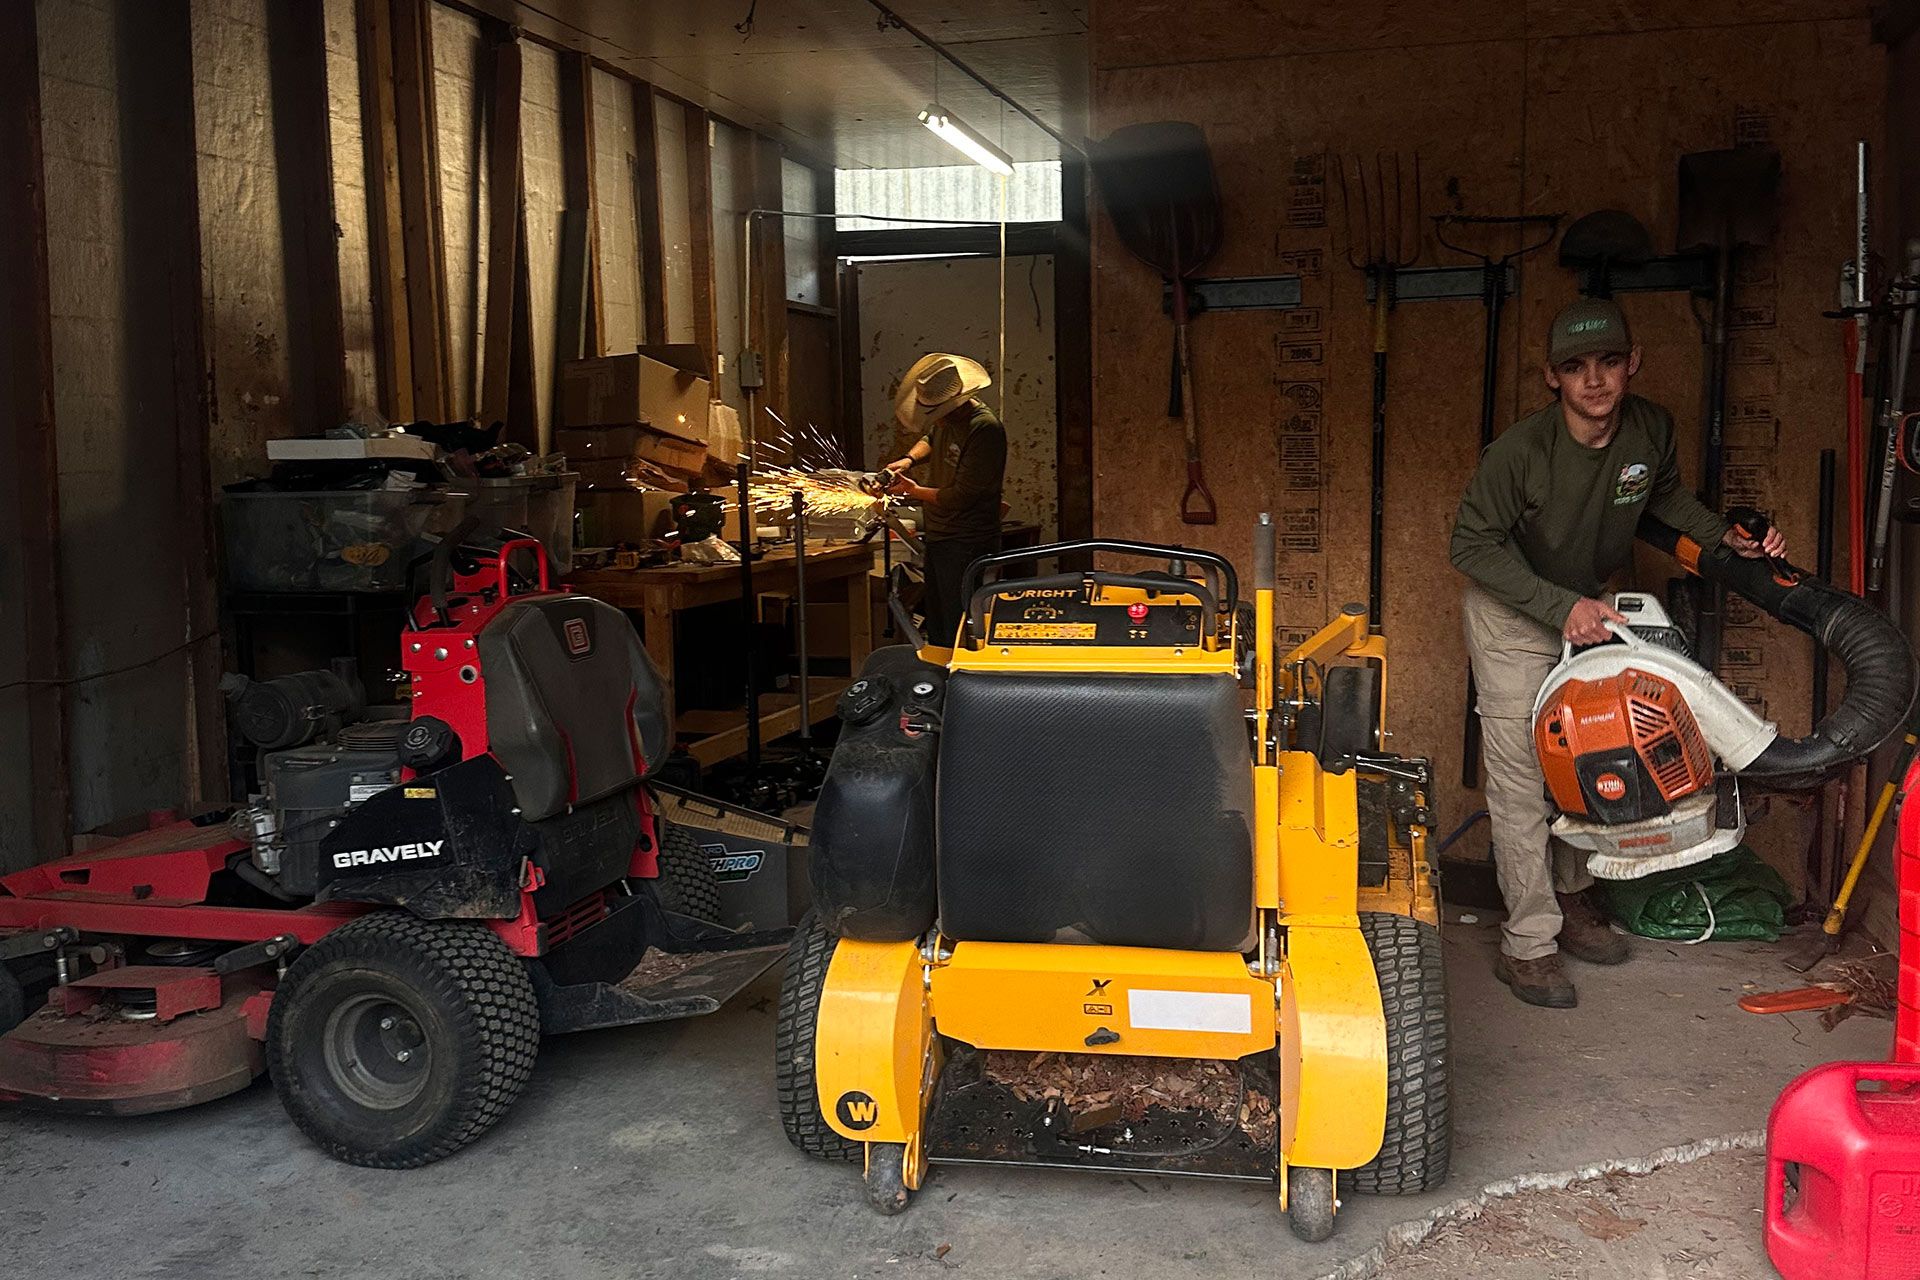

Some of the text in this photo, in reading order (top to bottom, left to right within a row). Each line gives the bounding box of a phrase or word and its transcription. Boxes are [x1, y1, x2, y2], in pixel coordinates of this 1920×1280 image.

[332, 840, 444, 869] GRAVELY
[1085, 979, 1112, 996] X
[846, 1101, 876, 1122] W
